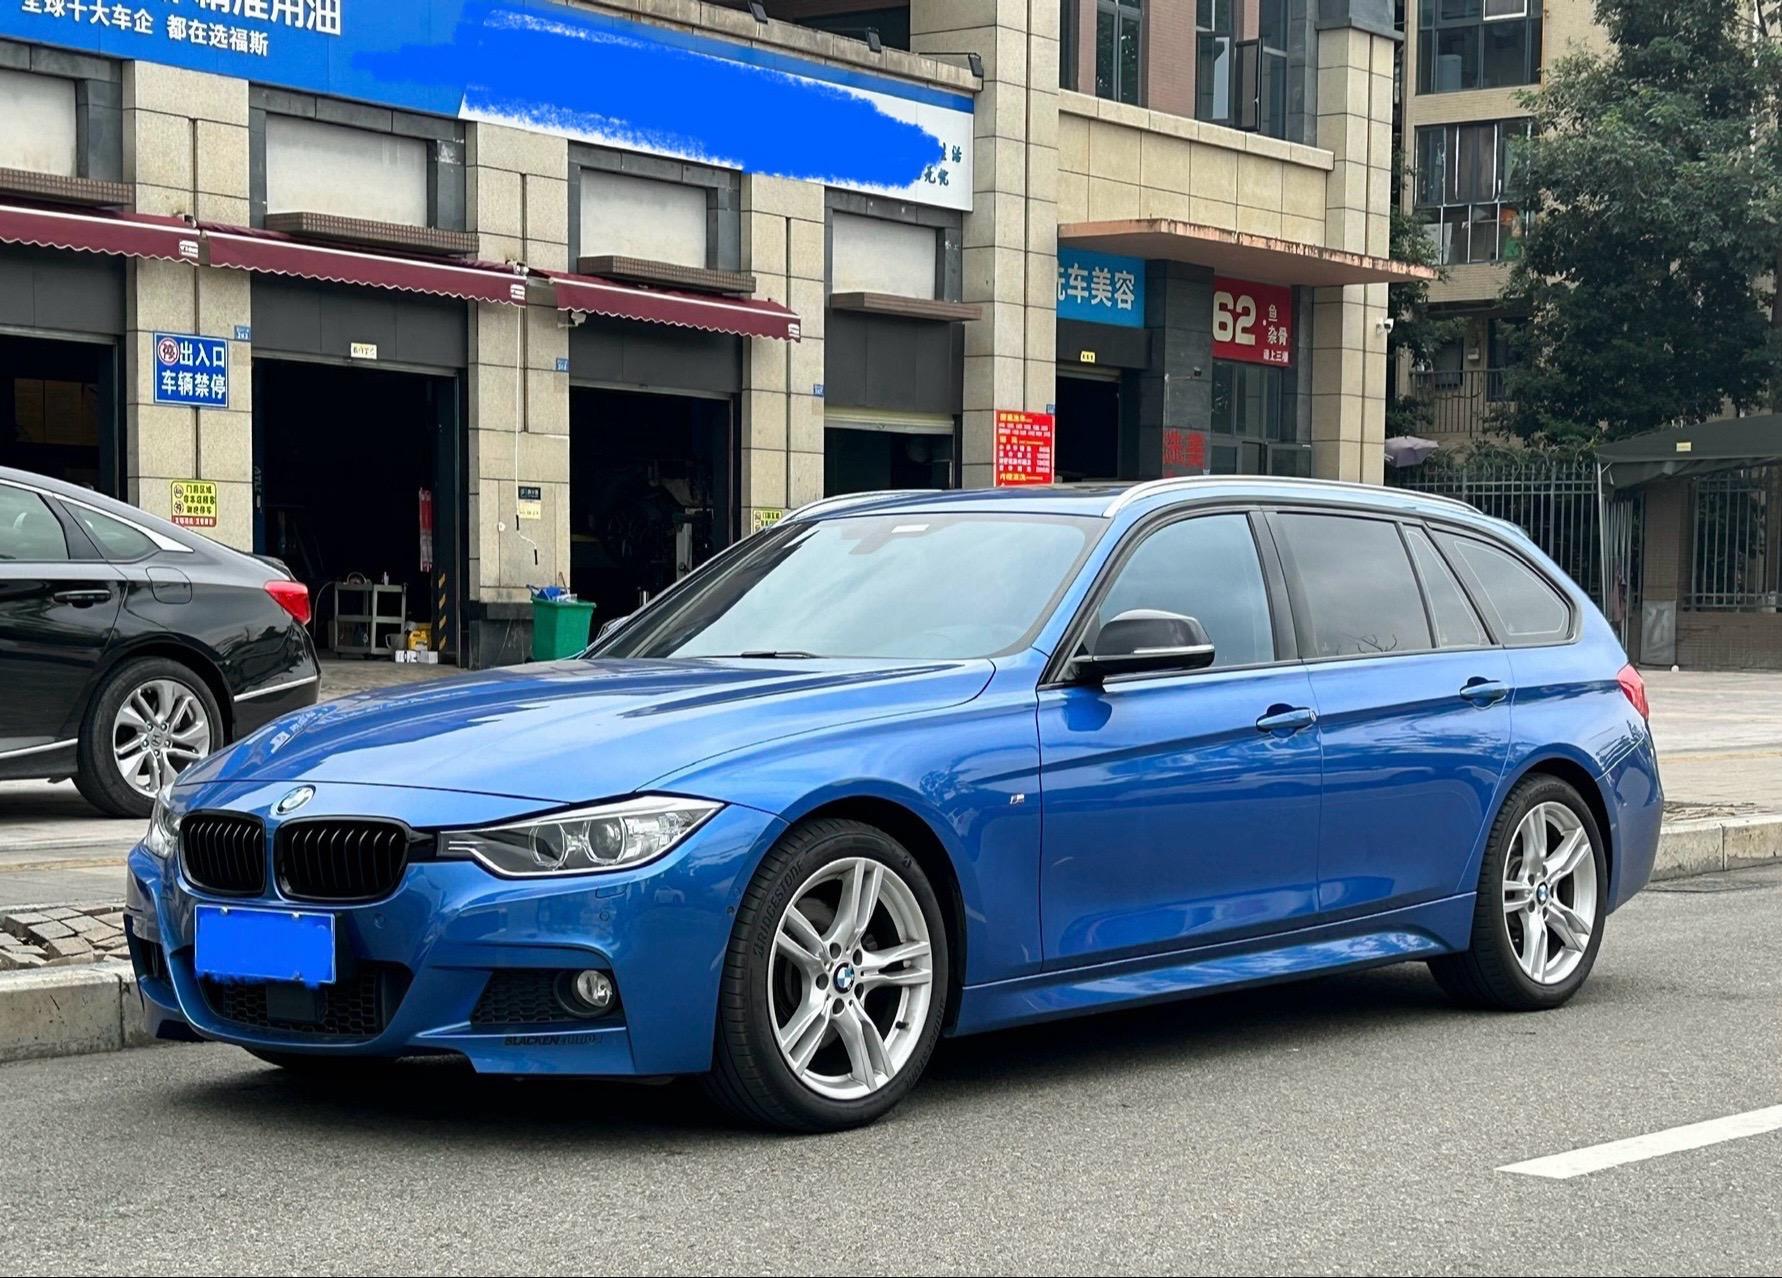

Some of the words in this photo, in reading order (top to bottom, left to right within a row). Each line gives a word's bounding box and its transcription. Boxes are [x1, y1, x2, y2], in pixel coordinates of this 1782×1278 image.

[166, 14, 269, 57] 都在选福斯
[1212, 290, 1257, 346] 62
[179, 340, 225, 368] 出入口
[161, 369, 226, 400] 车辆禁停
